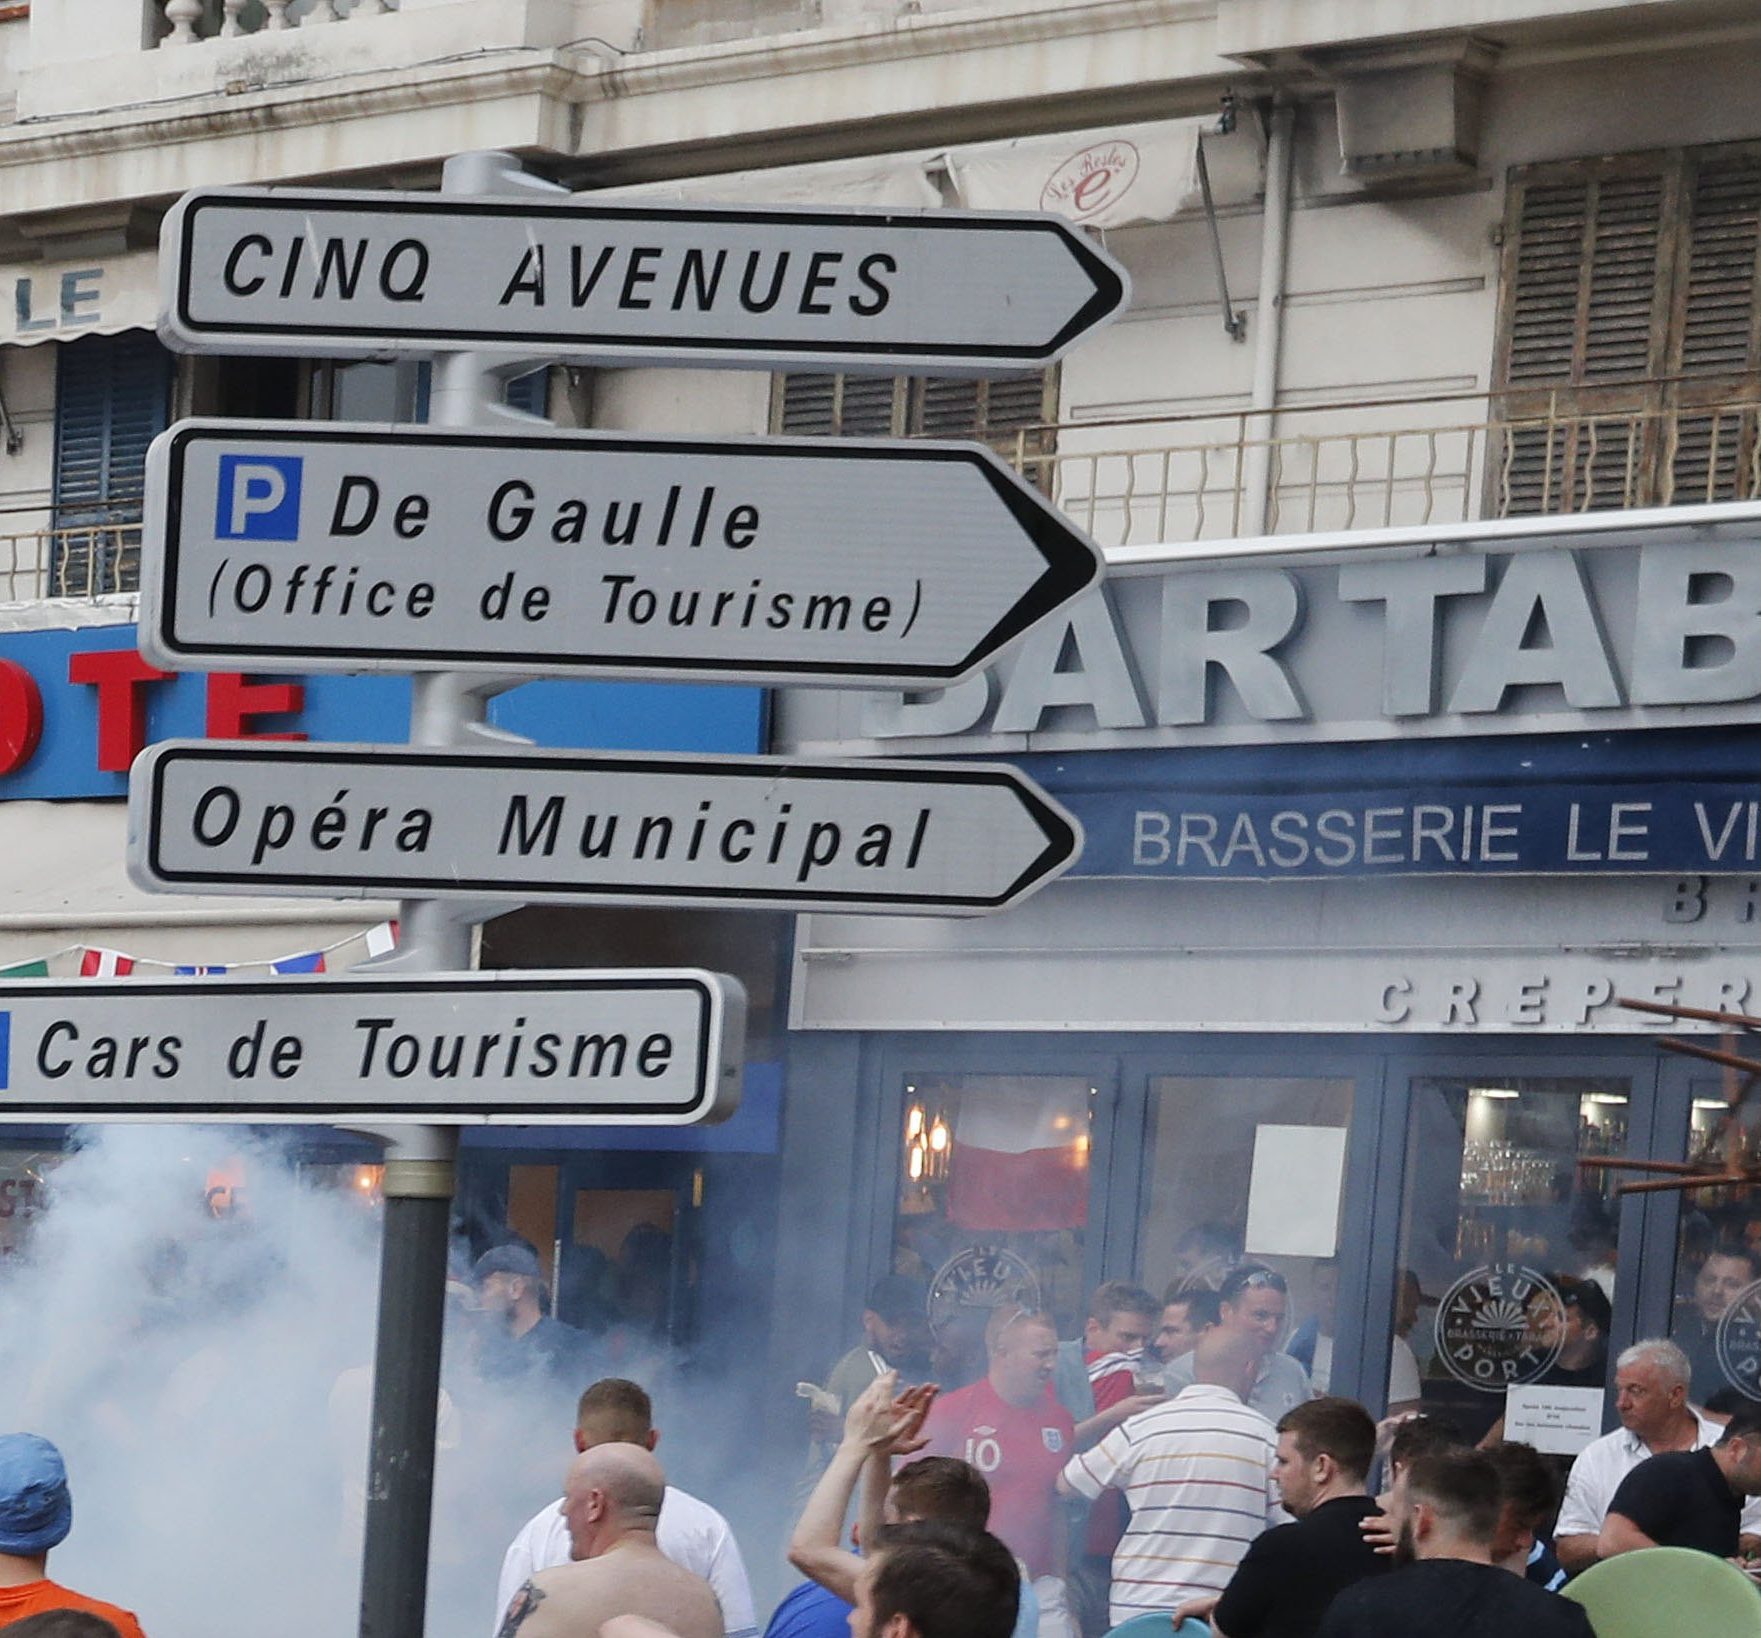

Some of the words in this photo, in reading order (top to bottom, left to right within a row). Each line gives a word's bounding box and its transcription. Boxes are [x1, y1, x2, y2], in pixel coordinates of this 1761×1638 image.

[15, 268, 104, 332] LE
[223, 233, 430, 303] CINQ
[498, 243, 897, 317] AVENUES
[231, 465, 286, 533] P
[328, 474, 430, 540] De
[487, 479, 760, 550] Gaulle
[208, 558, 435, 619] (Office
[479, 571, 551, 622] de
[600, 574, 923, 639] Tourisme)
[192, 785, 433, 866] Opéra
[497, 794, 931, 882] Municipal
[1133, 804, 1523, 868] BRASSERIE
[1566, 802, 1652, 862] LE
[37, 1020, 182, 1079] Cars
[227, 1019, 303, 1079] de
[355, 1017, 672, 1079] Tourisme
[1495, 1263, 1515, 1274] LE
[1453, 1344, 1540, 1379] PORT
[965, 1437, 1001, 1472] 10
